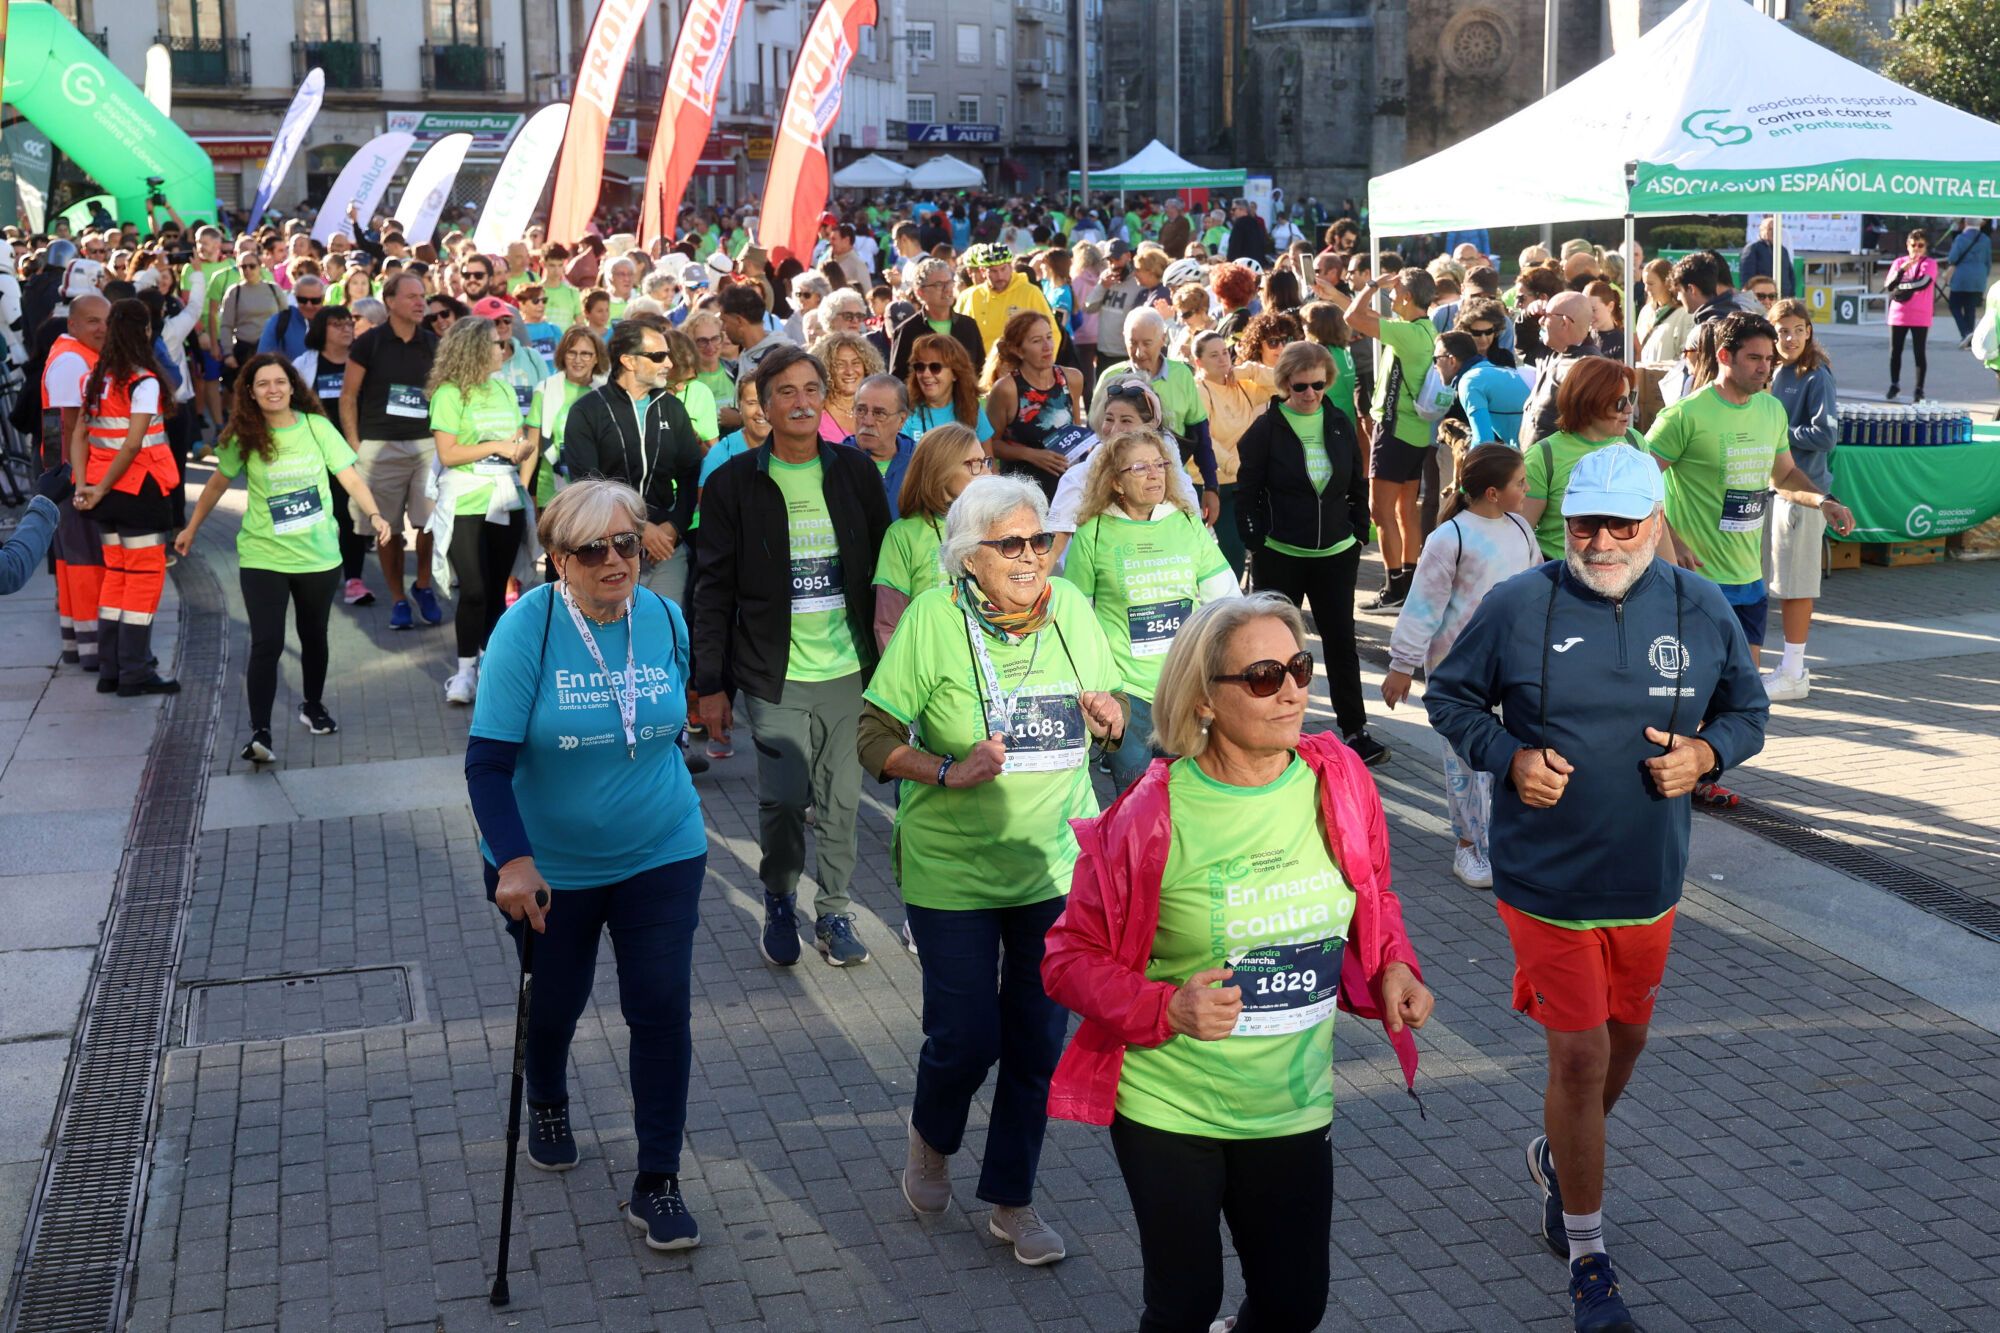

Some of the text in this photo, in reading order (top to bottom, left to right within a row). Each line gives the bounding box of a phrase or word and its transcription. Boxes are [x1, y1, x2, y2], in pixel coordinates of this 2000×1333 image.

[1747, 94, 1918, 114] asociación española
[1758, 108, 1892, 126] contra el cáncer
[1769, 120, 1893, 138] en Pontevedra
[1781, 167, 1886, 193] ESPAÑOLA
[1891, 175, 1973, 198] CONTRA
[1816, 291, 1823, 307] 1
[1844, 304, 1851, 316] 2
[1058, 430, 1082, 448] 1529
[284, 500, 312, 515] 1341
[1124, 554, 1191, 570] En marcha
[793, 576, 831, 591] 0951
[1125, 568, 1194, 586] contra o
[1147, 617, 1180, 633] 2545
[555, 669, 585, 689] En
[1014, 718, 1066, 739] 1083
[1227, 884, 1258, 908] En
[1226, 896, 1351, 940] contra o
[1241, 957, 1276, 965] marcha
[1266, 964, 1294, 973] cancro
[1256, 969, 1317, 995] 1829
